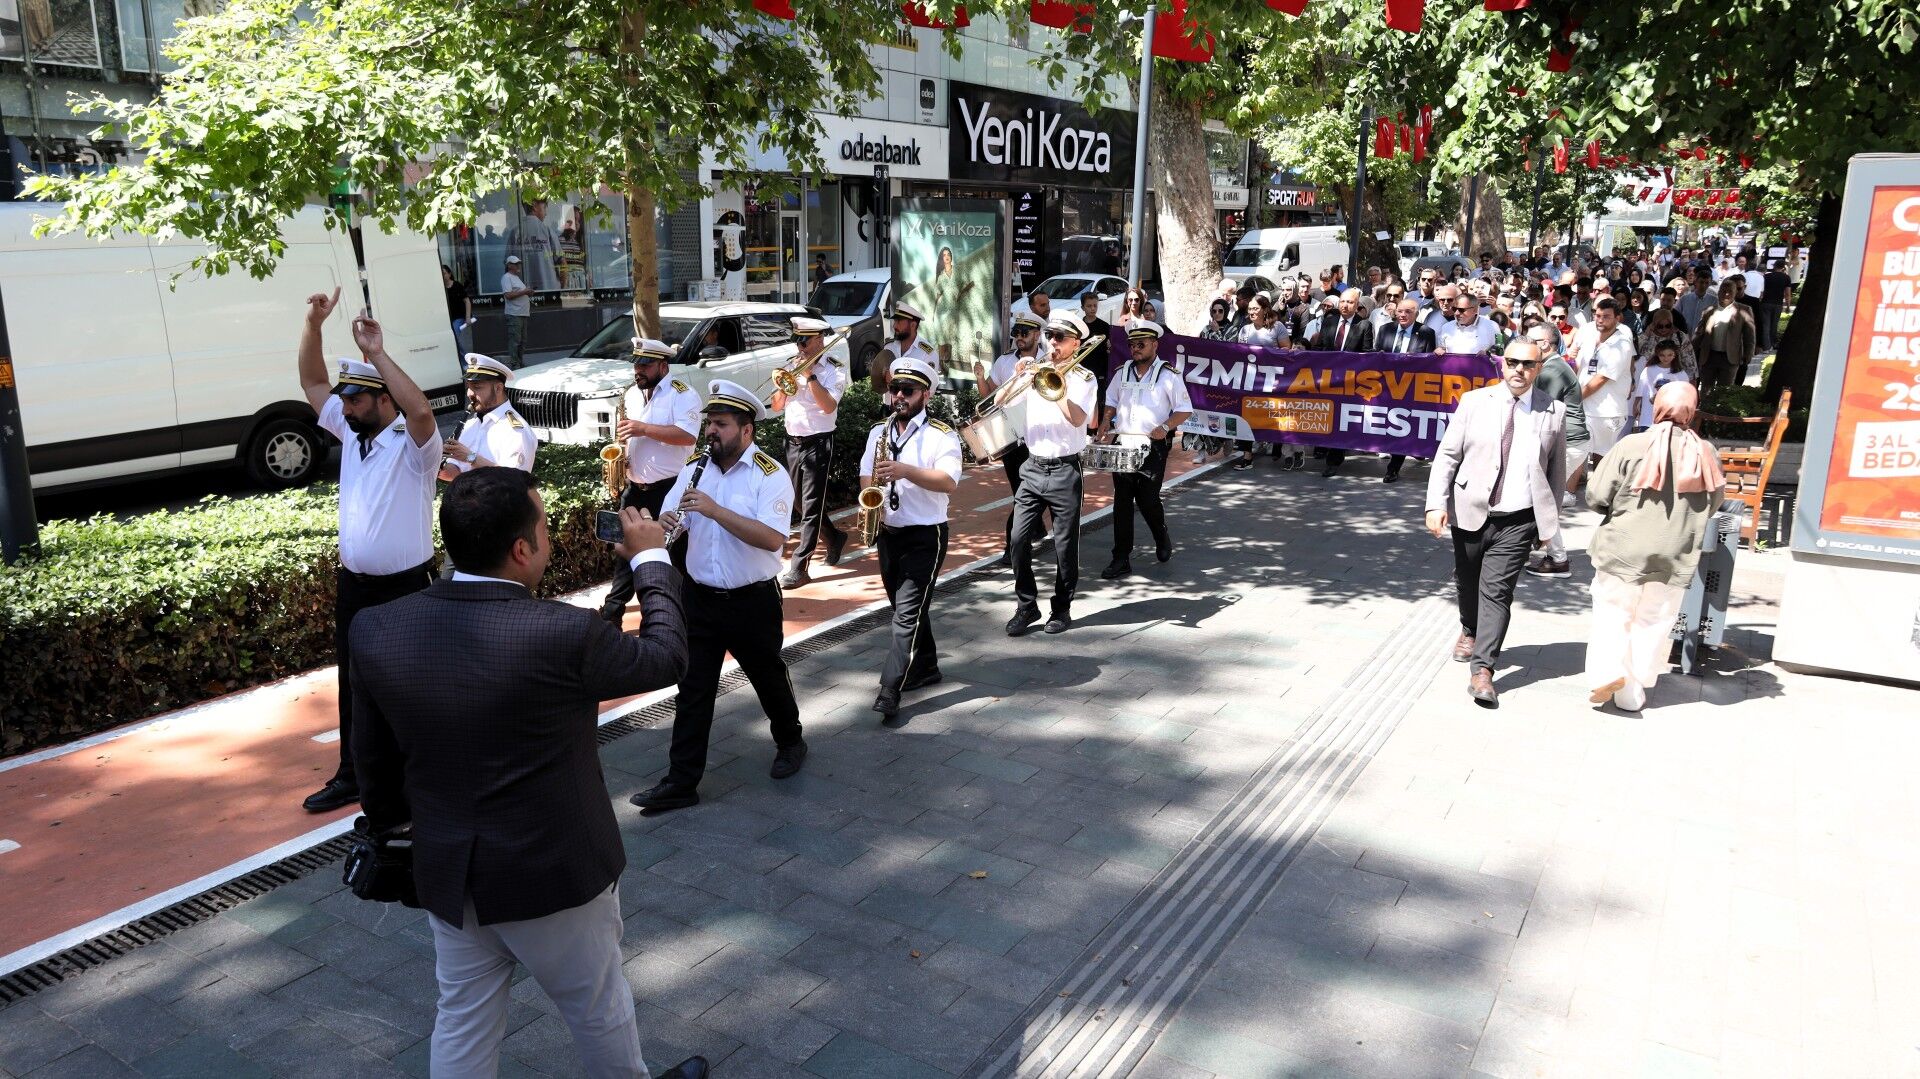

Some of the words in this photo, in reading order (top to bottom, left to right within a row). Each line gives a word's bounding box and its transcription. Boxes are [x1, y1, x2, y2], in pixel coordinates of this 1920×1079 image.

[841, 132, 921, 166] odeabank
[1174, 344, 1285, 393] İZMİT
[1286, 367, 1502, 405] ALIŞVER
[1245, 399, 1276, 409] 24-28
[1278, 399, 1330, 411] HAZİRAN
[1299, 411, 1329, 422] KENT
[1278, 419, 1329, 432] MEYDANI
[1339, 402, 1456, 441] FESTİ
